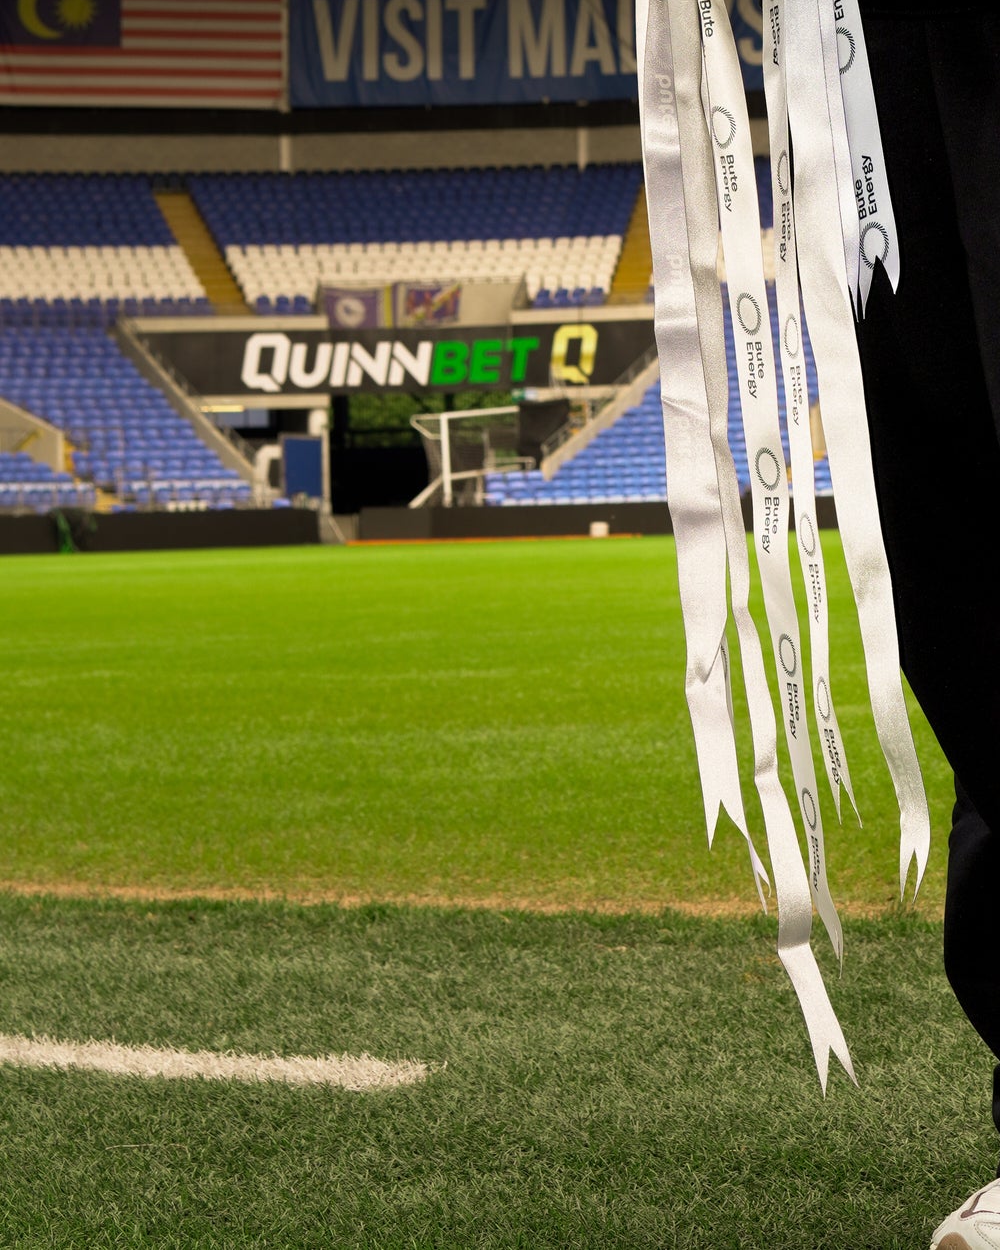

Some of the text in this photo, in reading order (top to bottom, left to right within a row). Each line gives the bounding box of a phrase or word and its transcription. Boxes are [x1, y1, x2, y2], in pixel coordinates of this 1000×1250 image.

[700, 0, 714, 38] Bute
[720, 155, 732, 213] Energy
[726, 154, 738, 192] Bute
[861, 154, 878, 216] Energy
[855, 179, 868, 220] Bute
[241, 332, 540, 392] QUINNBET
[746, 341, 758, 399] Energy
[754, 341, 764, 379] Bute
[789, 366, 799, 426] Energy
[795, 365, 803, 405] Bute
[761, 496, 772, 554] Energy
[771, 496, 780, 535] Bute
[786, 682, 797, 740] Energy
[792, 683, 800, 721] Bute
[823, 728, 840, 785] Energy
[829, 729, 842, 768] Bute
